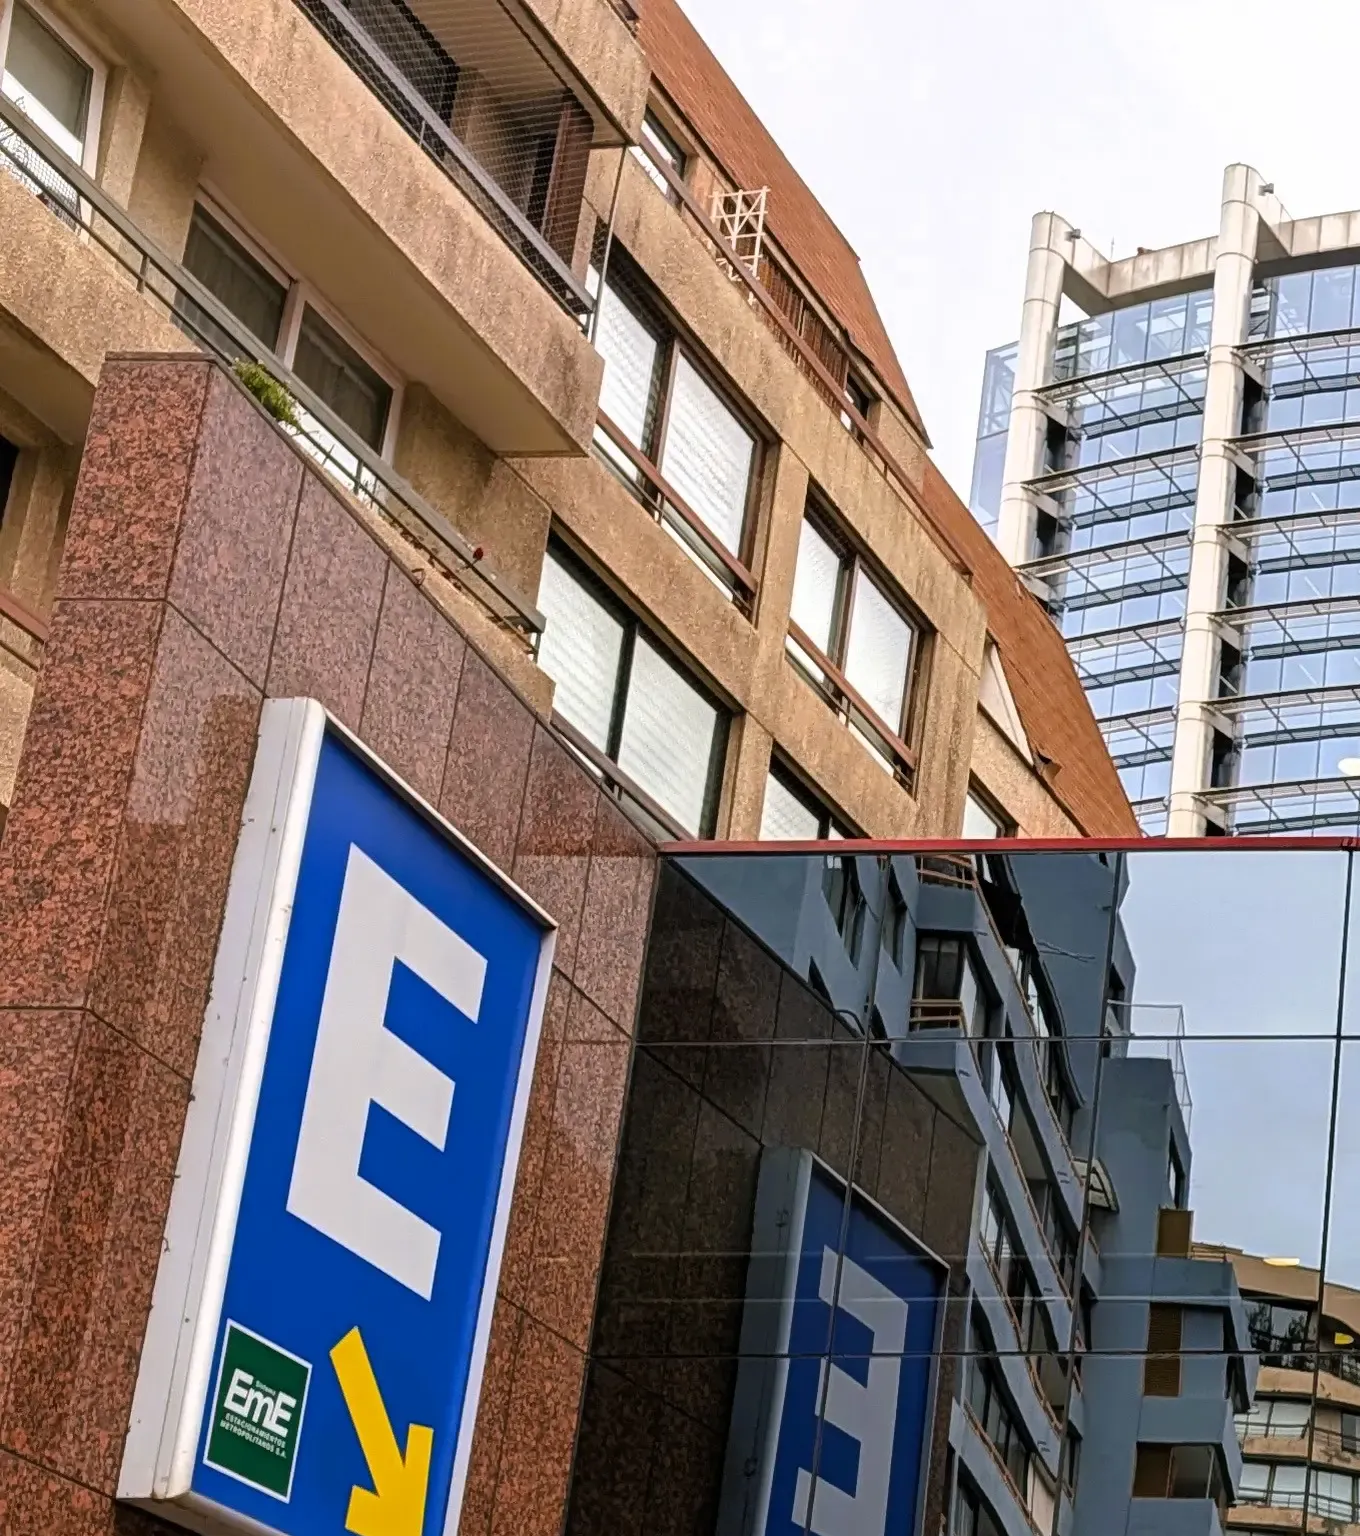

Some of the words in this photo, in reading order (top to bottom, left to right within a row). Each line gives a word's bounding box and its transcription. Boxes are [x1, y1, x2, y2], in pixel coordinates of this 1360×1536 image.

[286, 843, 487, 1301] E
[220, 1419, 275, 1453] METROPOLITANOS
[225, 1412, 286, 1448] ESTACIONAMIENTOS
